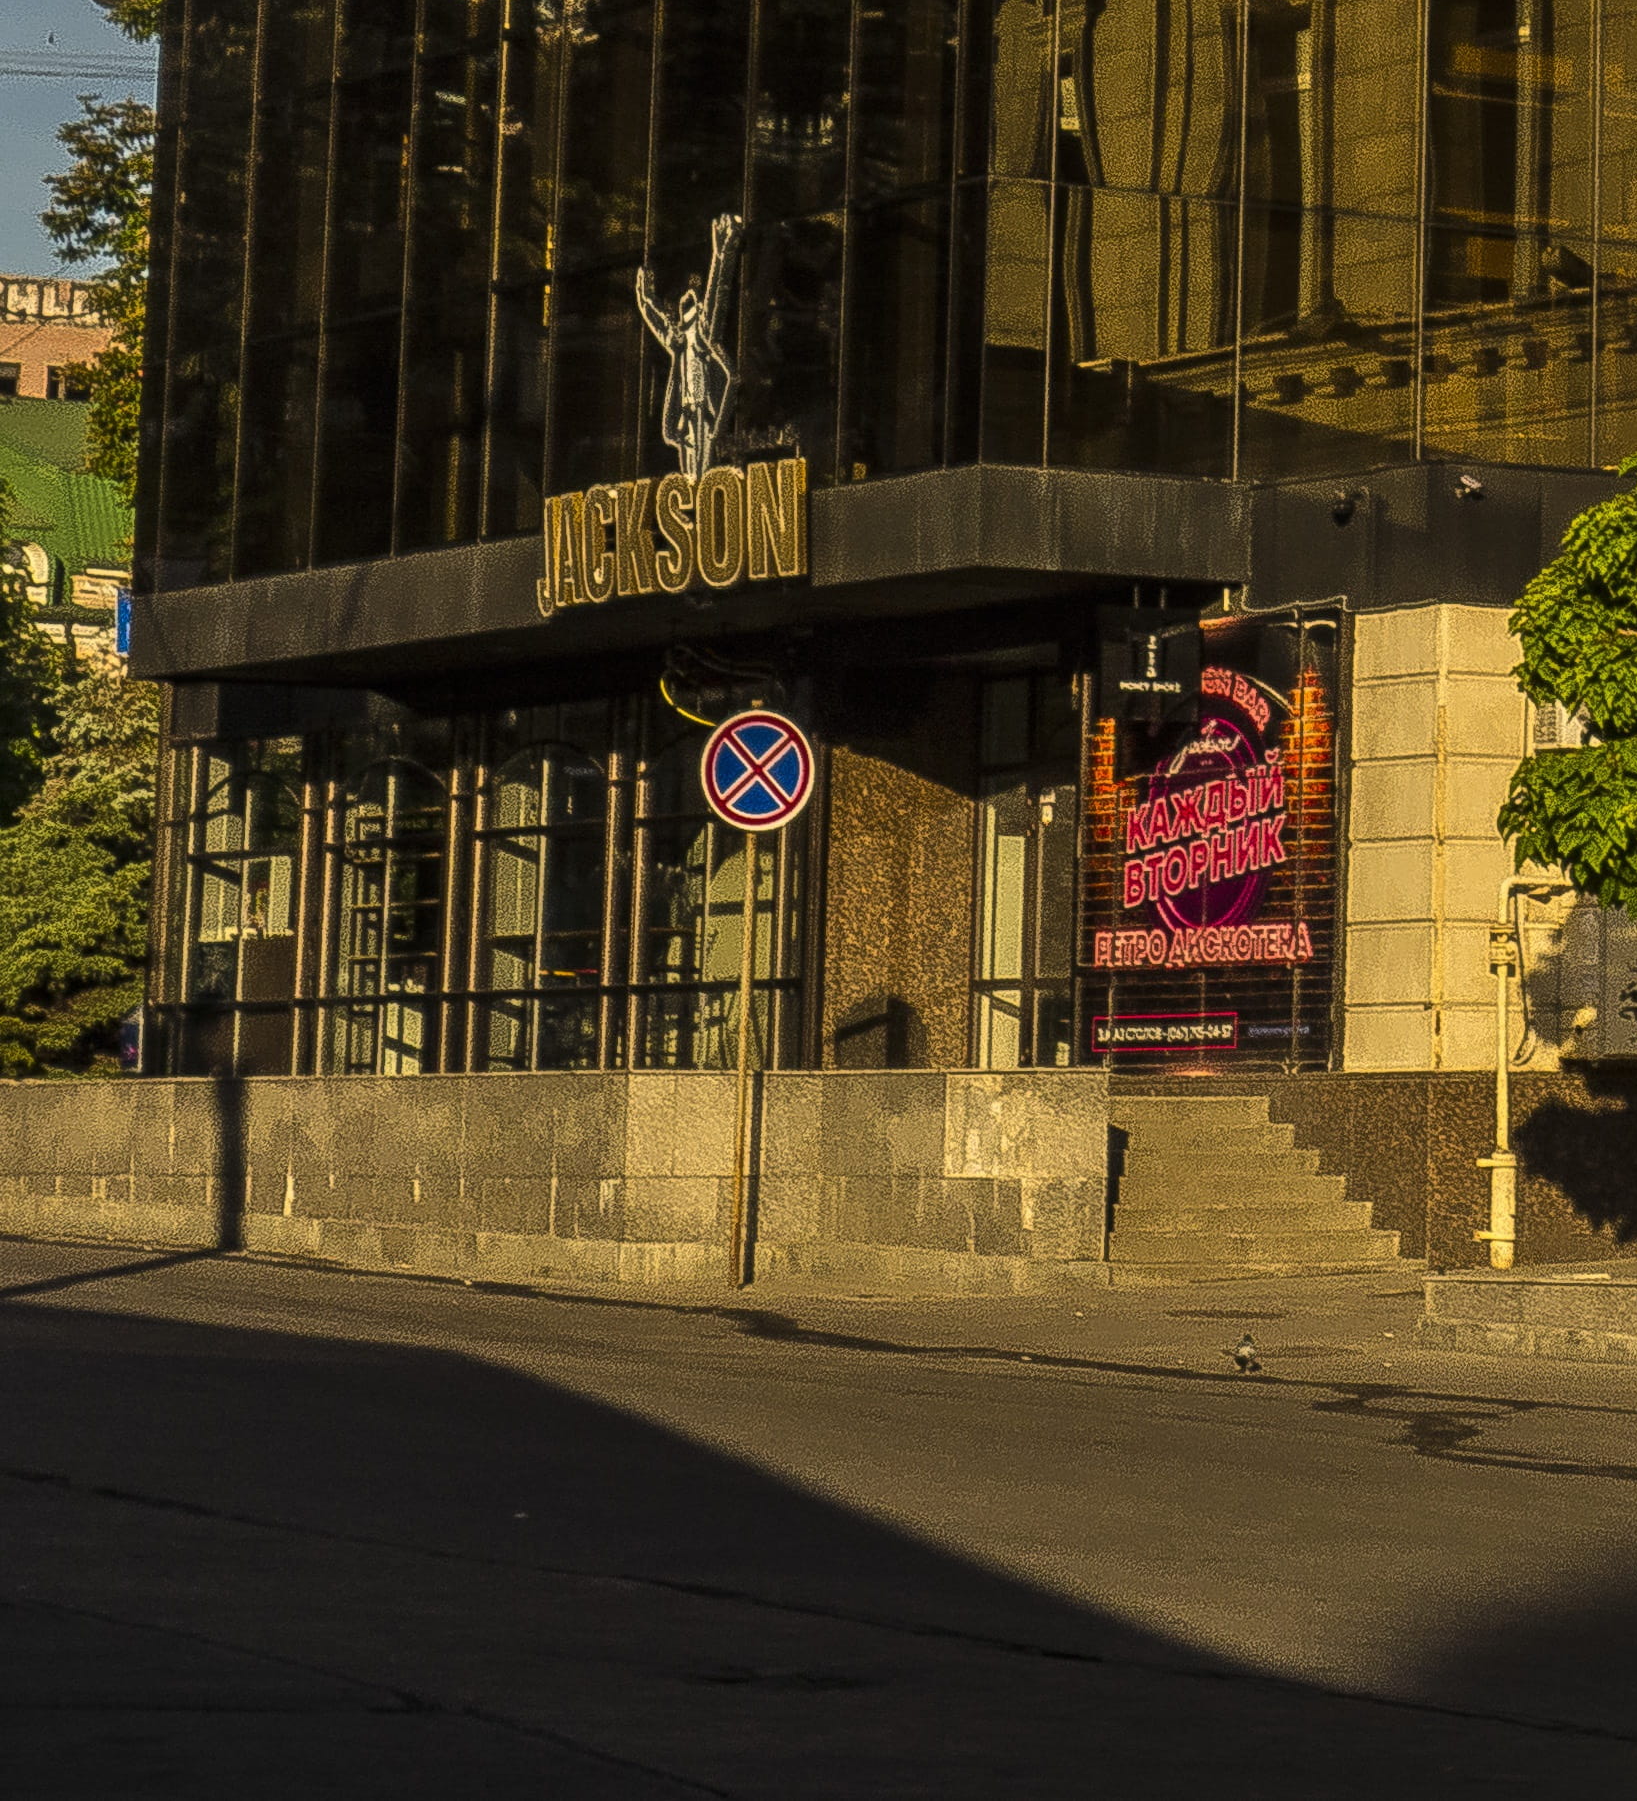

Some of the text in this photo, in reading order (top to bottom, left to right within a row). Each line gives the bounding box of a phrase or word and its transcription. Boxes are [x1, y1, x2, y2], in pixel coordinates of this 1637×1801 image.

[537, 457, 807, 618] JACKSON
[1126, 747, 1286, 854] КАЖДЫЙ
[1124, 813, 1287, 909] ВТОРНИК
